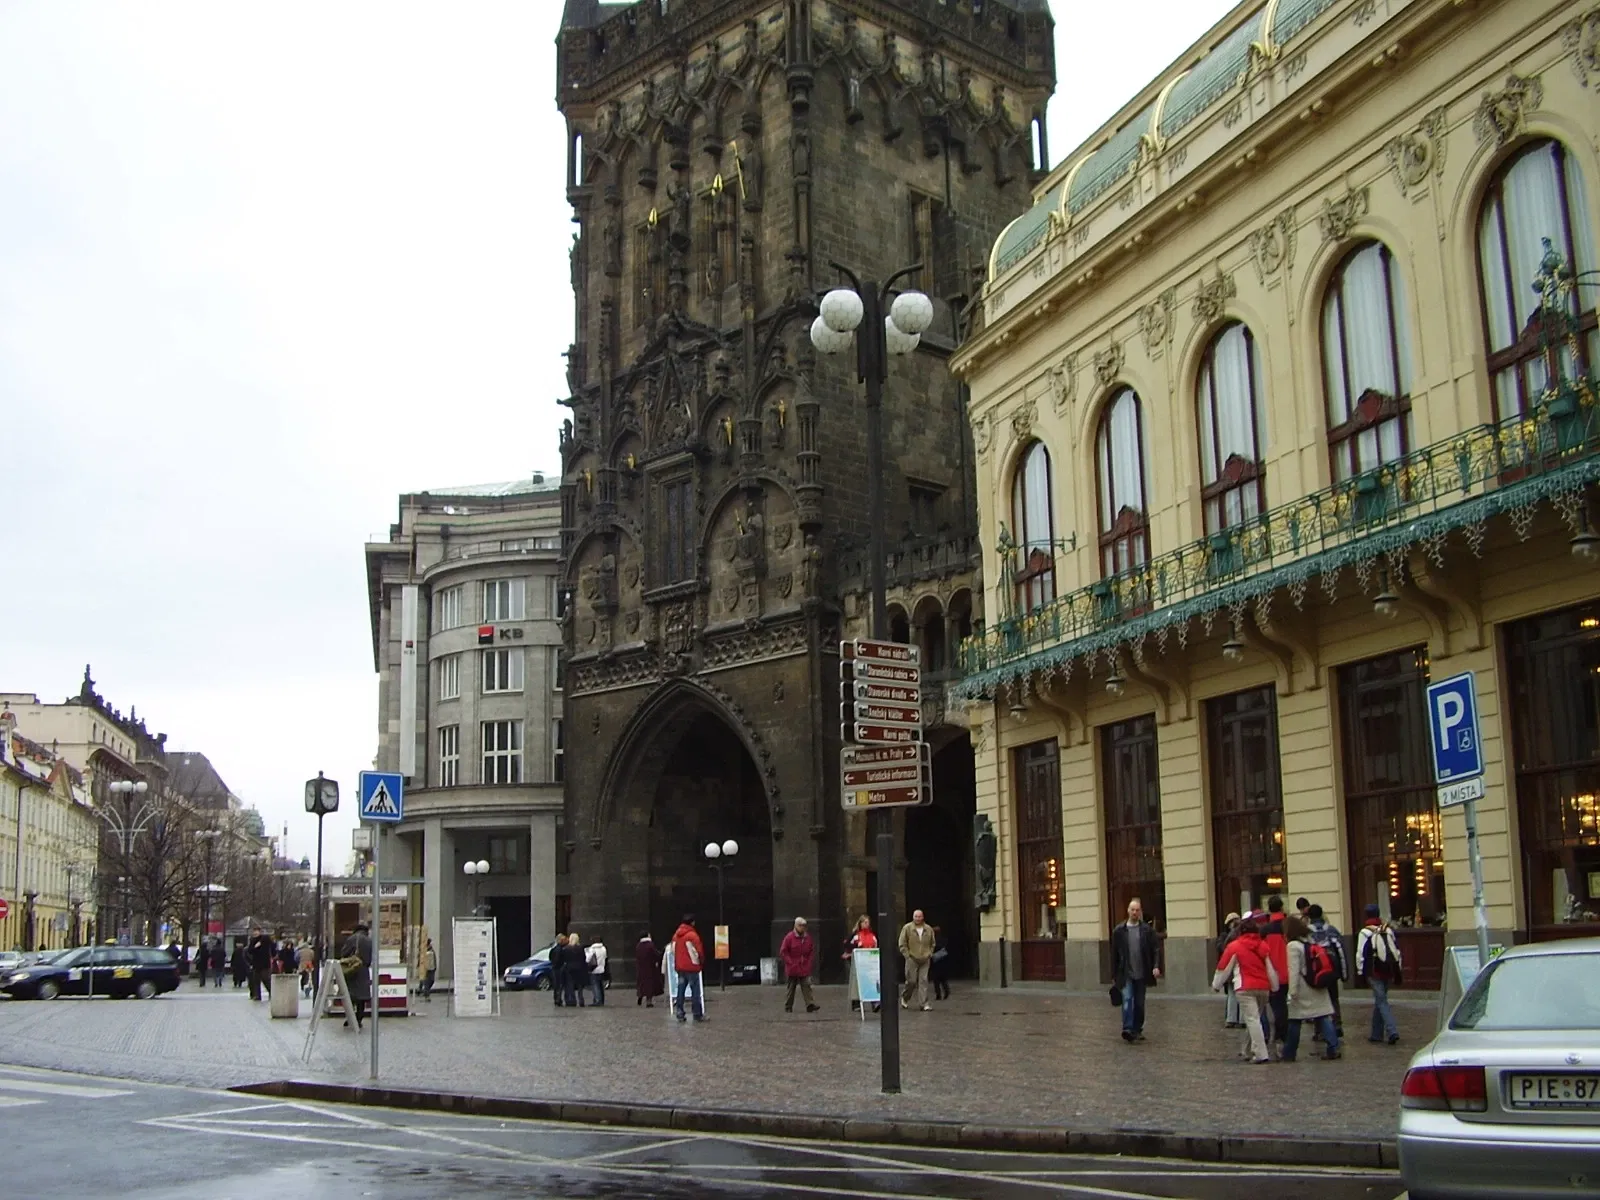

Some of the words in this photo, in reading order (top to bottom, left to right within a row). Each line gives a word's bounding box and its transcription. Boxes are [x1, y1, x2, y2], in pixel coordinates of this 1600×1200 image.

[499, 628, 523, 640] KB
[1437, 691, 1464, 750] P
[866, 770, 891, 782] Turistické
[891, 768, 917, 780] informace
[868, 792, 886, 803] Metro
[1443, 792, 1448, 805] 2
[1450, 787, 1477, 802] MÍSTA
[380, 884, 397, 894] SHIP
[1522, 1079, 1558, 1098] PIE
